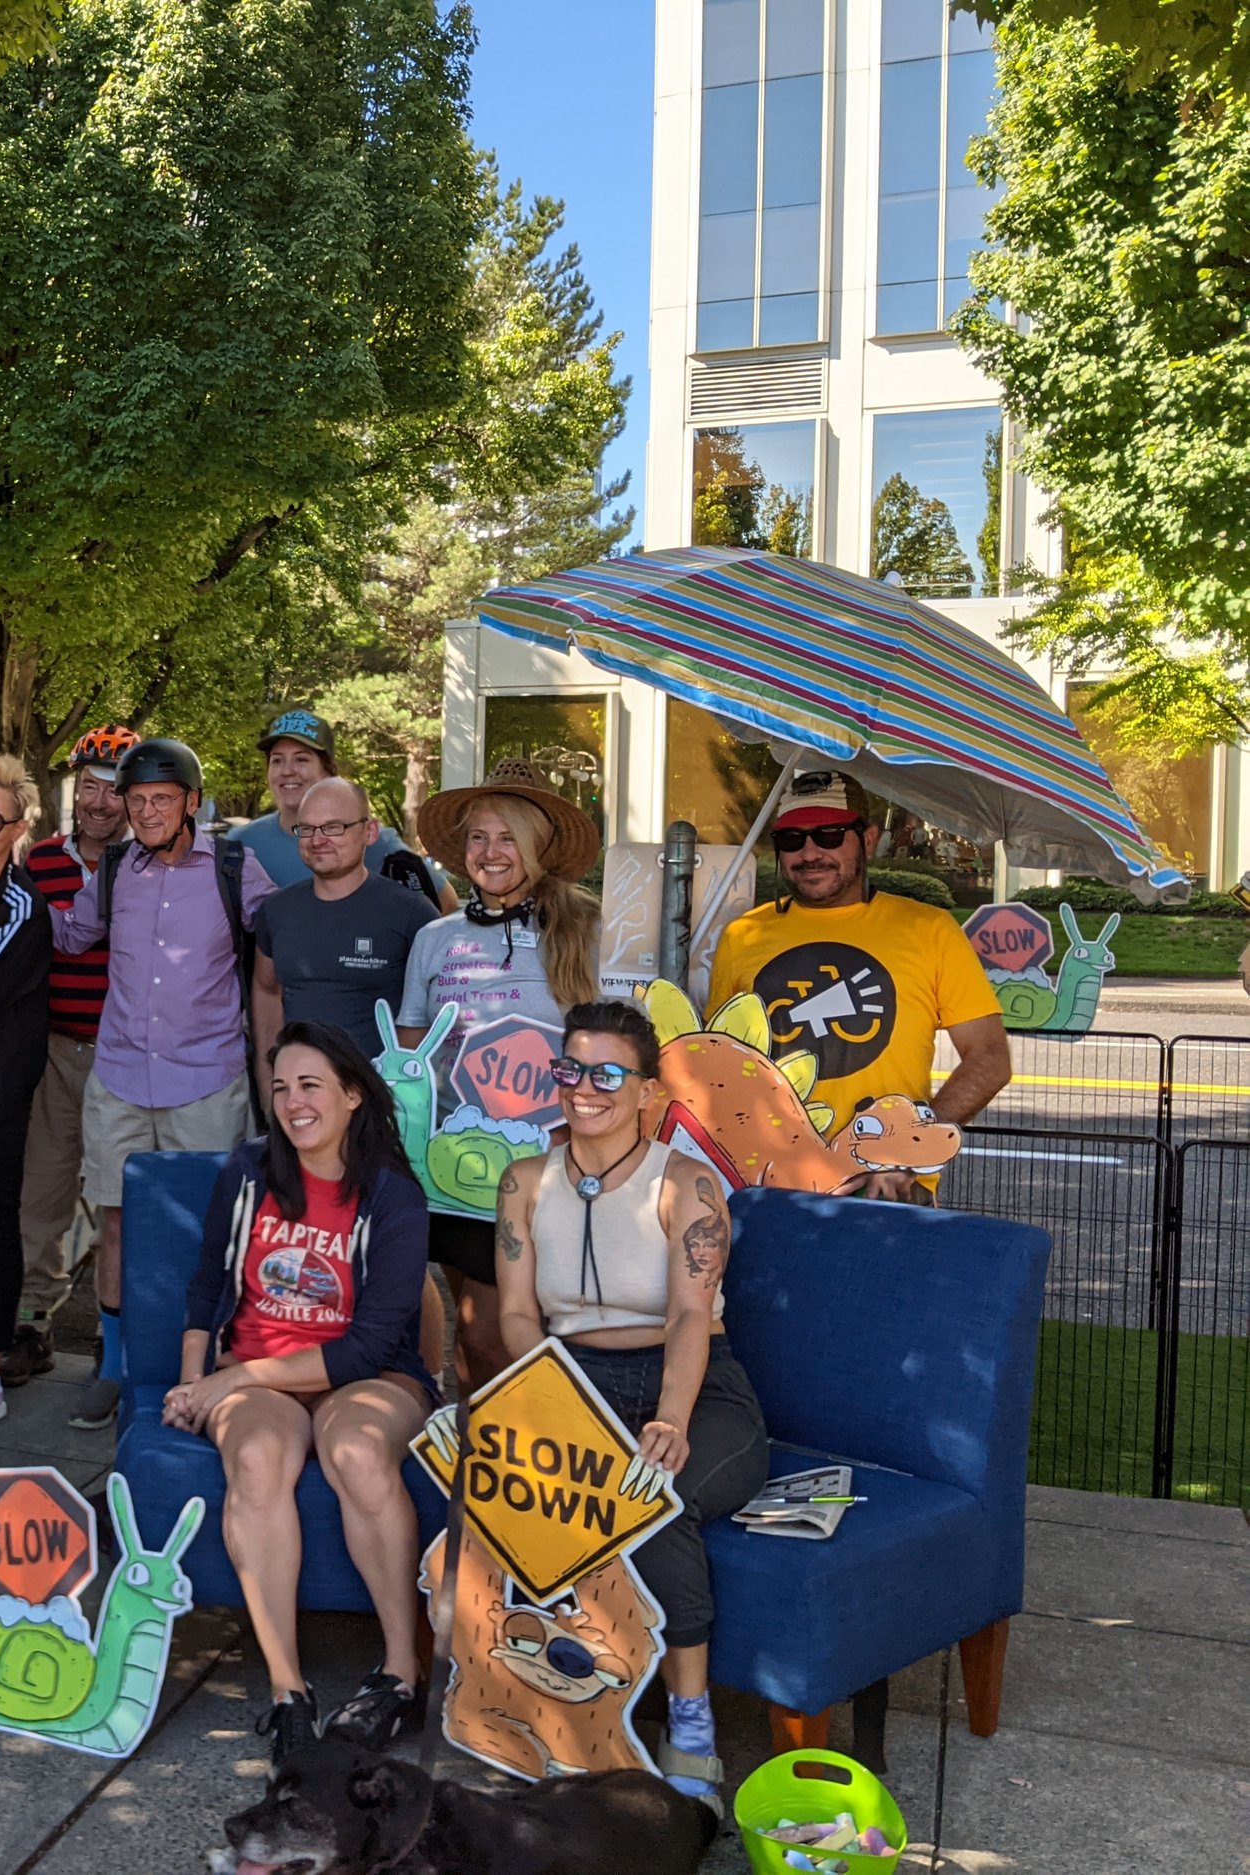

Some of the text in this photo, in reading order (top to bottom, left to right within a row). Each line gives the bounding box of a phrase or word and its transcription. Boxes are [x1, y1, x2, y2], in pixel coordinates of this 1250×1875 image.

[446, 943, 480, 957] Roll &
[978, 927, 1035, 956] SLOW
[441, 960, 512, 973] Streetcar &
[437, 975, 470, 987] Bus &
[435, 988, 521, 1004] Aerial Tram &
[475, 1047, 555, 1103] SLOW
[479, 1423, 615, 1489] SLOW
[470, 1461, 616, 1537] DOWN
